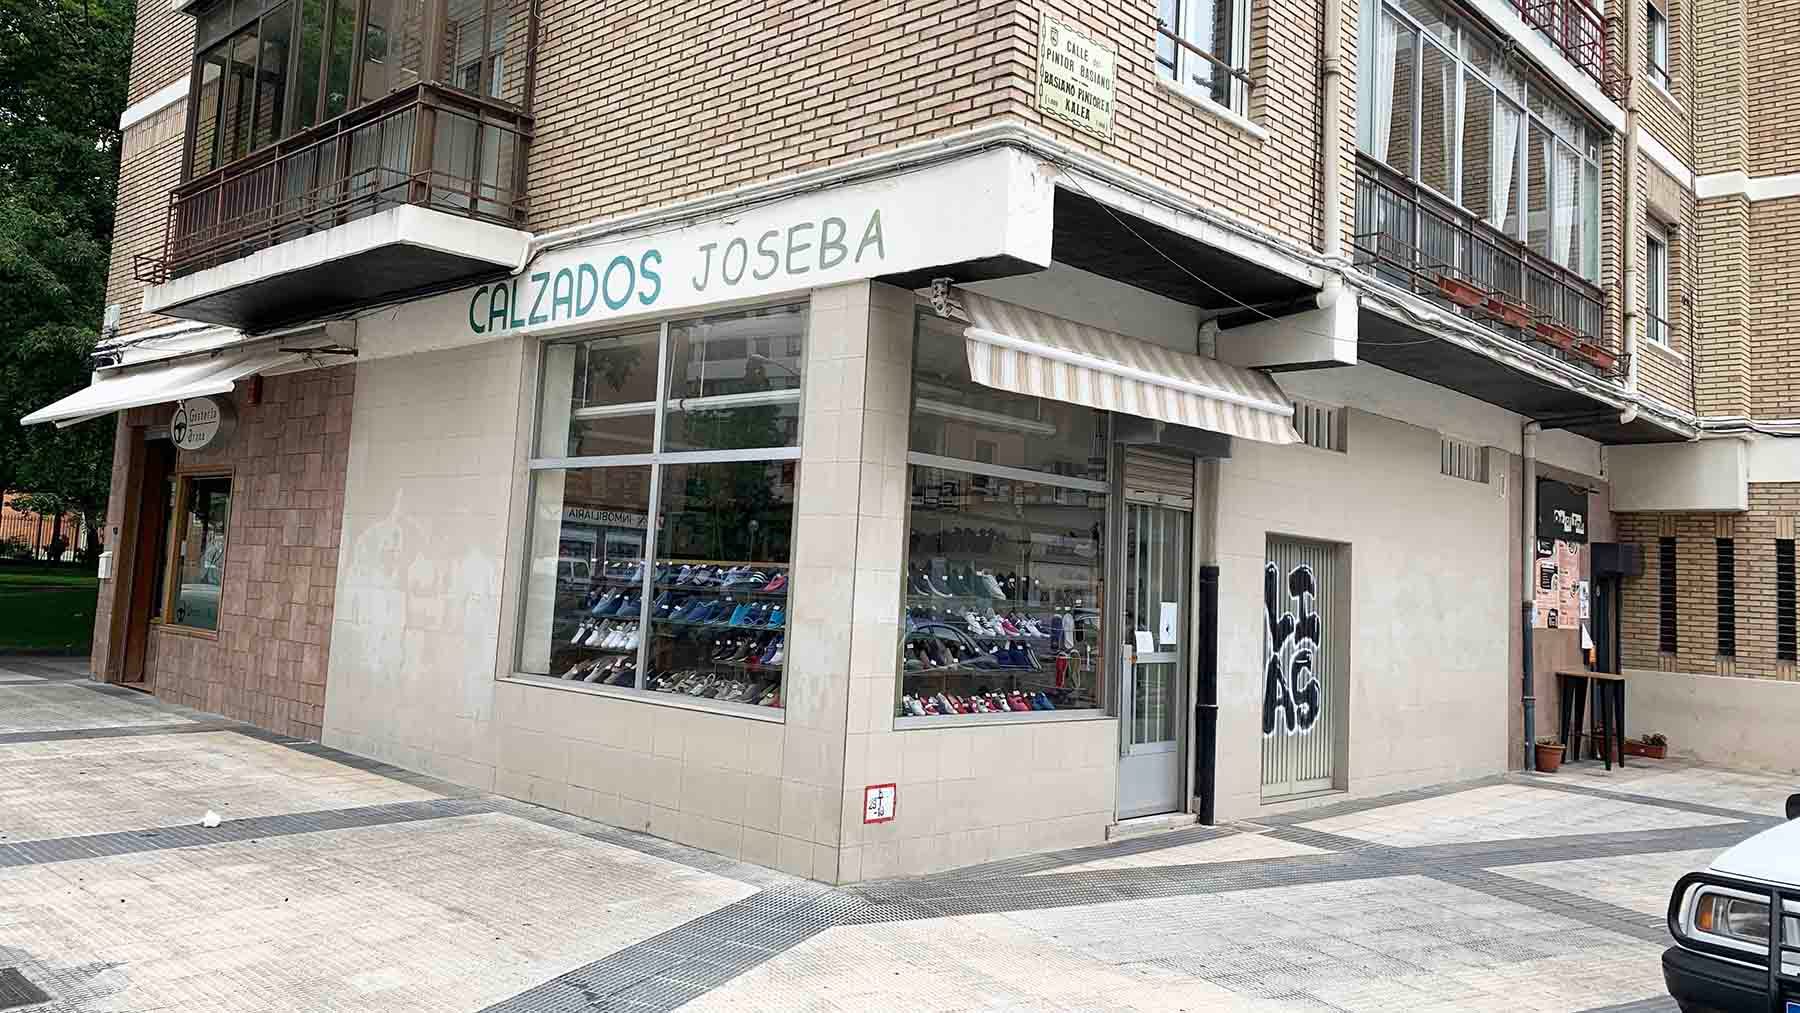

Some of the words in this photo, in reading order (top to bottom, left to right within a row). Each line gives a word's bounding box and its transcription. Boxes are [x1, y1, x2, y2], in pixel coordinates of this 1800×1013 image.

[1047, 48, 1075, 72] PINTOR
[1080, 65, 1110, 90] BASIANO
[1067, 41, 1088, 62] CALLE
[1044, 71, 1075, 97] BASIANO
[1078, 88, 1109, 113] PINTOREA
[1065, 98, 1090, 122] KALEA
[469, 249, 663, 334] CALZADOS
[692, 208, 886, 292] JOSEBA
